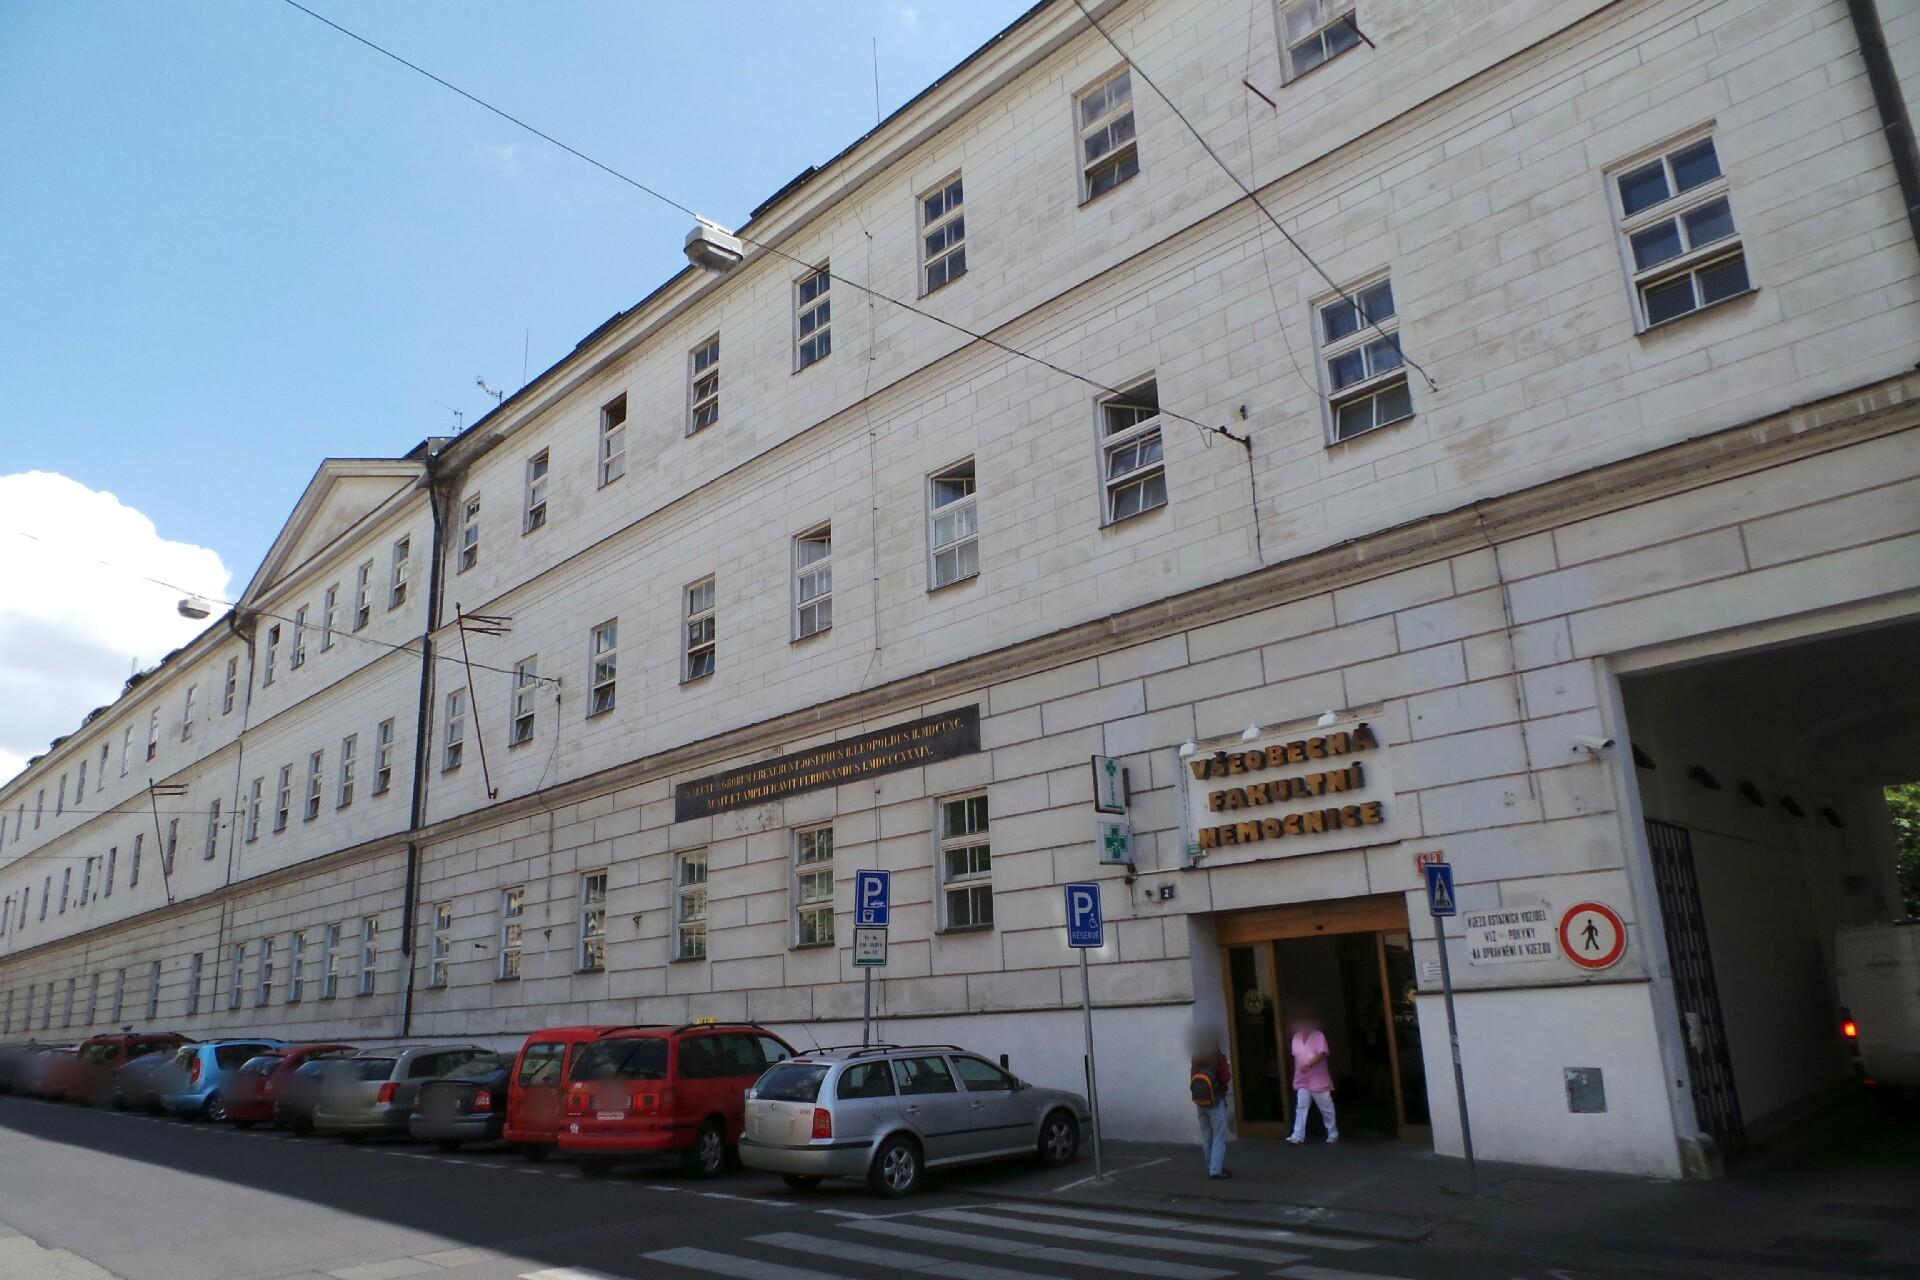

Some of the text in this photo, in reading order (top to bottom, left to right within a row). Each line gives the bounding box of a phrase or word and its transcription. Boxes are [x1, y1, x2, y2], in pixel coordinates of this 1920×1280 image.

[801, 750, 844, 769] JOSEPHUS
[854, 731, 910, 754] LEOPOLDUS
[1190, 722, 1379, 780] VŠEOBECNÁ
[799, 763, 861, 787] FERDINANDUS
[1208, 760, 1366, 812] FAKULTNÍ
[1198, 801, 1384, 849] NEMOCNICE
[863, 877, 883, 908] P
[1072, 891, 1093, 927] P
[1164, 889, 1169, 898] 2
[1484, 930, 1497, 942] VIZ
[1508, 927, 1536, 940] POKYNY
